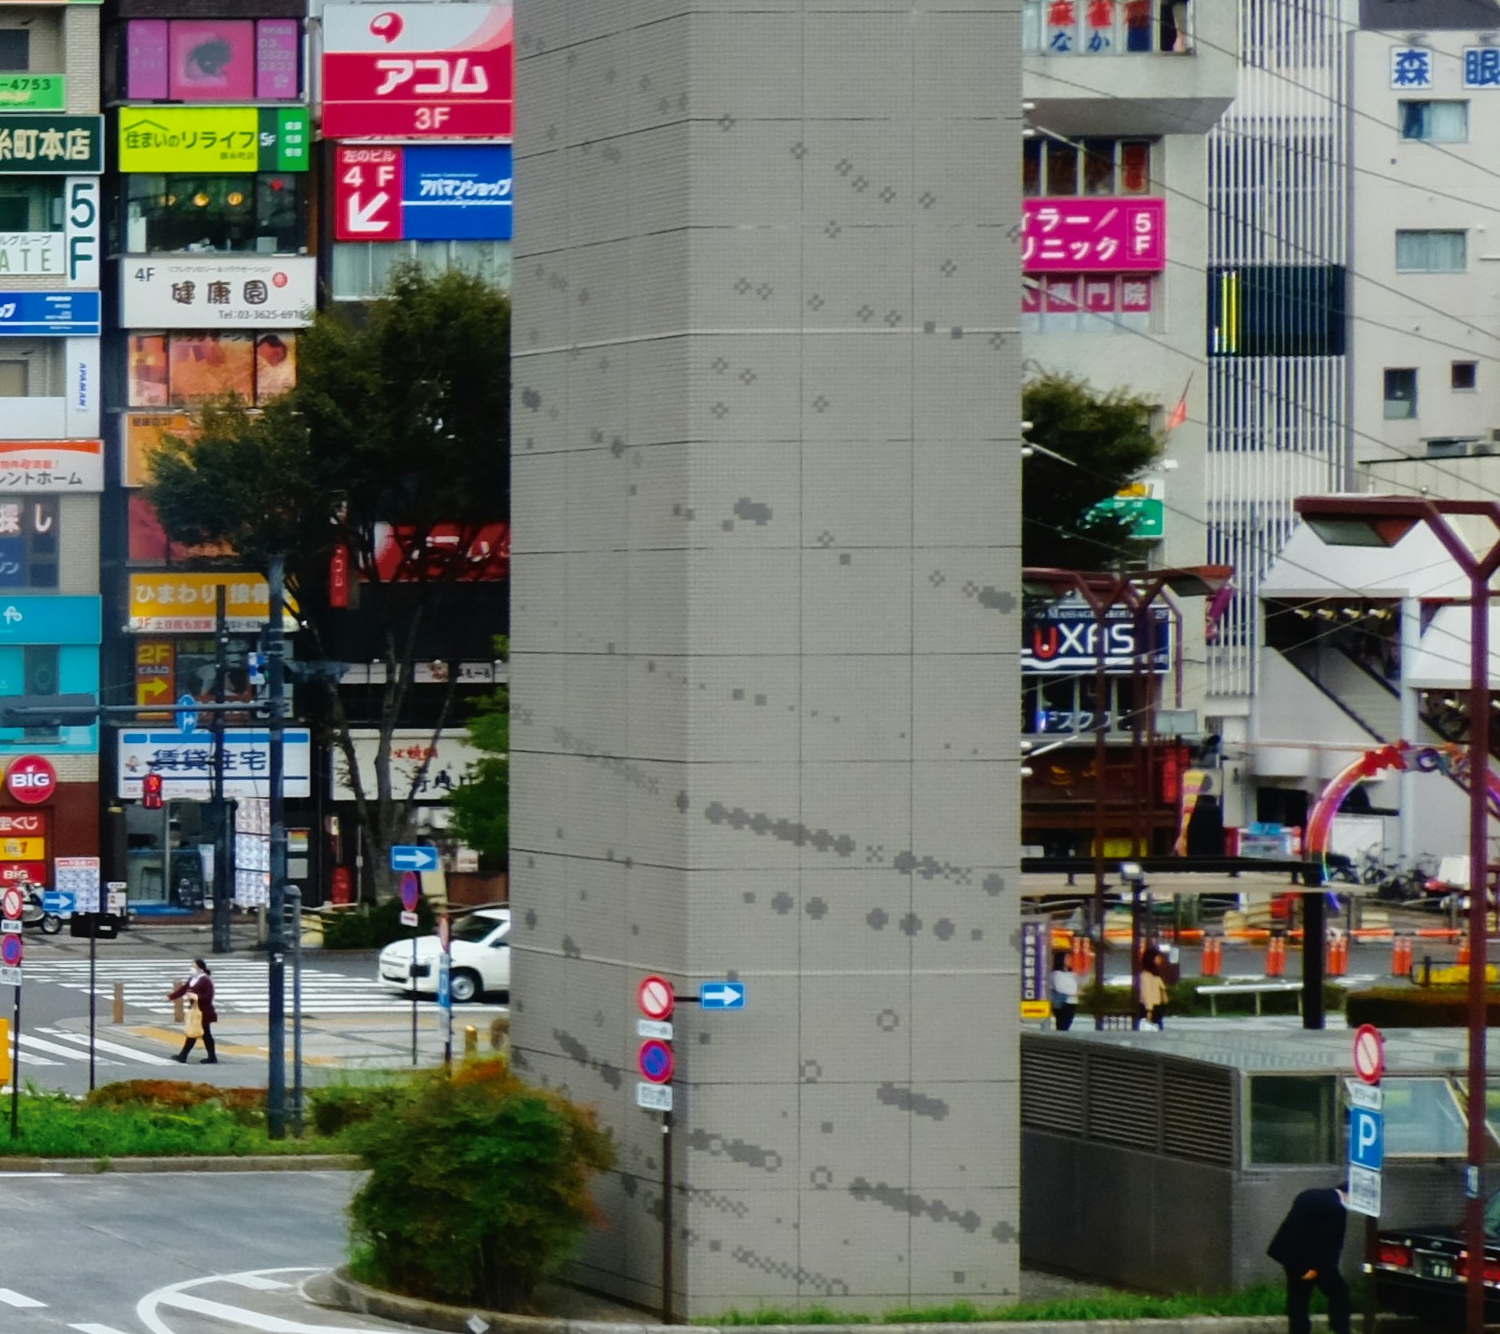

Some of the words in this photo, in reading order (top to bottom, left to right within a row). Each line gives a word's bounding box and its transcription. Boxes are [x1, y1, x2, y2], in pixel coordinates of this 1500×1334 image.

[376, 58, 489, 96] アコム
[1392, 49, 1431, 86] 森
[1465, 49, 1500, 86] 眼
[415, 107, 451, 129] 3F
[125, 131, 255, 150] 住まいのリライフ
[1135, 212, 1152, 256] 5F
[134, 267, 155, 282] 4F
[171, 280, 268, 305] 健康園
[135, 583, 216, 604] ひまわり
[1021, 622, 1135, 658] UXAS
[138, 645, 171, 664] 2F
[11, 765, 50, 788] BIG
[1358, 1113, 1377, 1160] P
